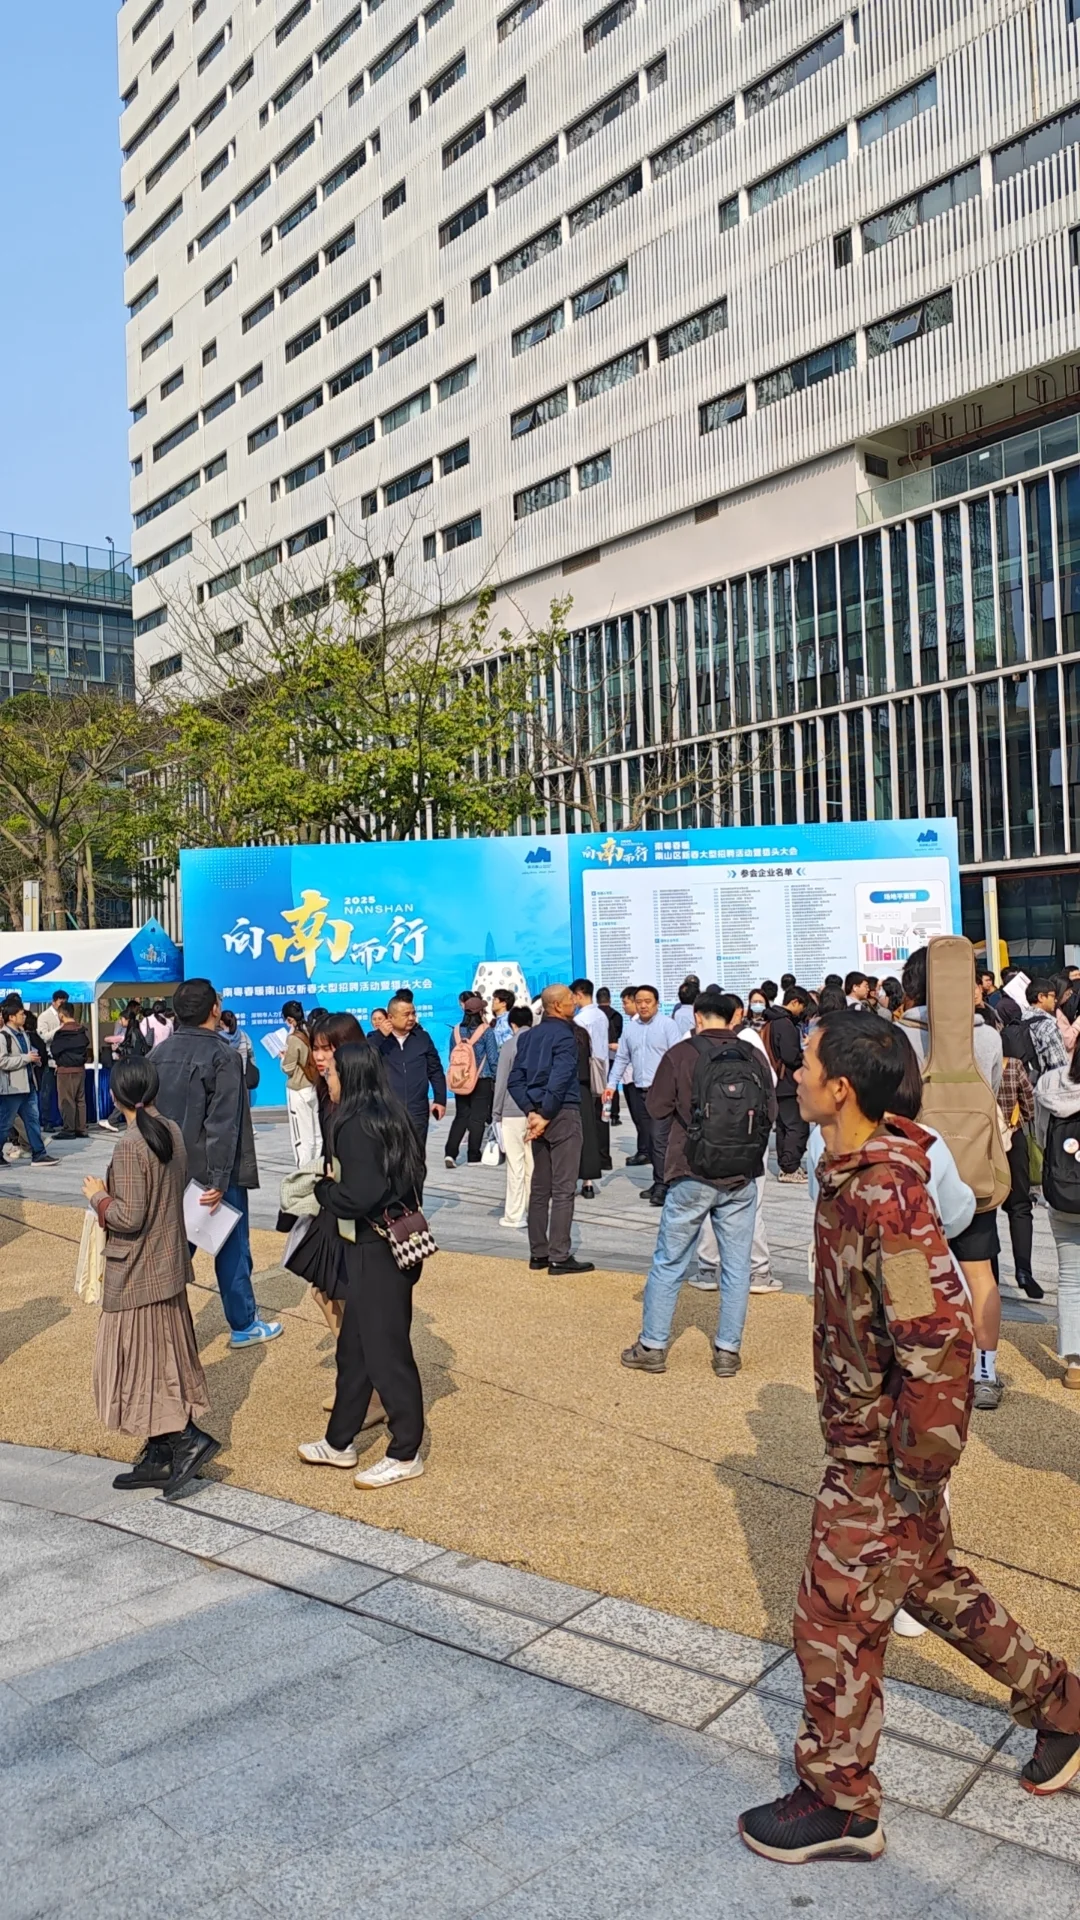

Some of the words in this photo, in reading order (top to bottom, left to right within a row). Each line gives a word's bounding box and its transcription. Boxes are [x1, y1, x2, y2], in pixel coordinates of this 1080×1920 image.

[582, 837, 648, 866] 向南而行
[740, 867, 793, 878] 参会企业名单
[344, 895, 376, 905] 2025
[344, 903, 414, 915] NANSHAN
[222, 888, 429, 980] 向南而行
[222, 978, 433, 998] 南粤春暖南山区新春大型招聘活动暨猎头大会
